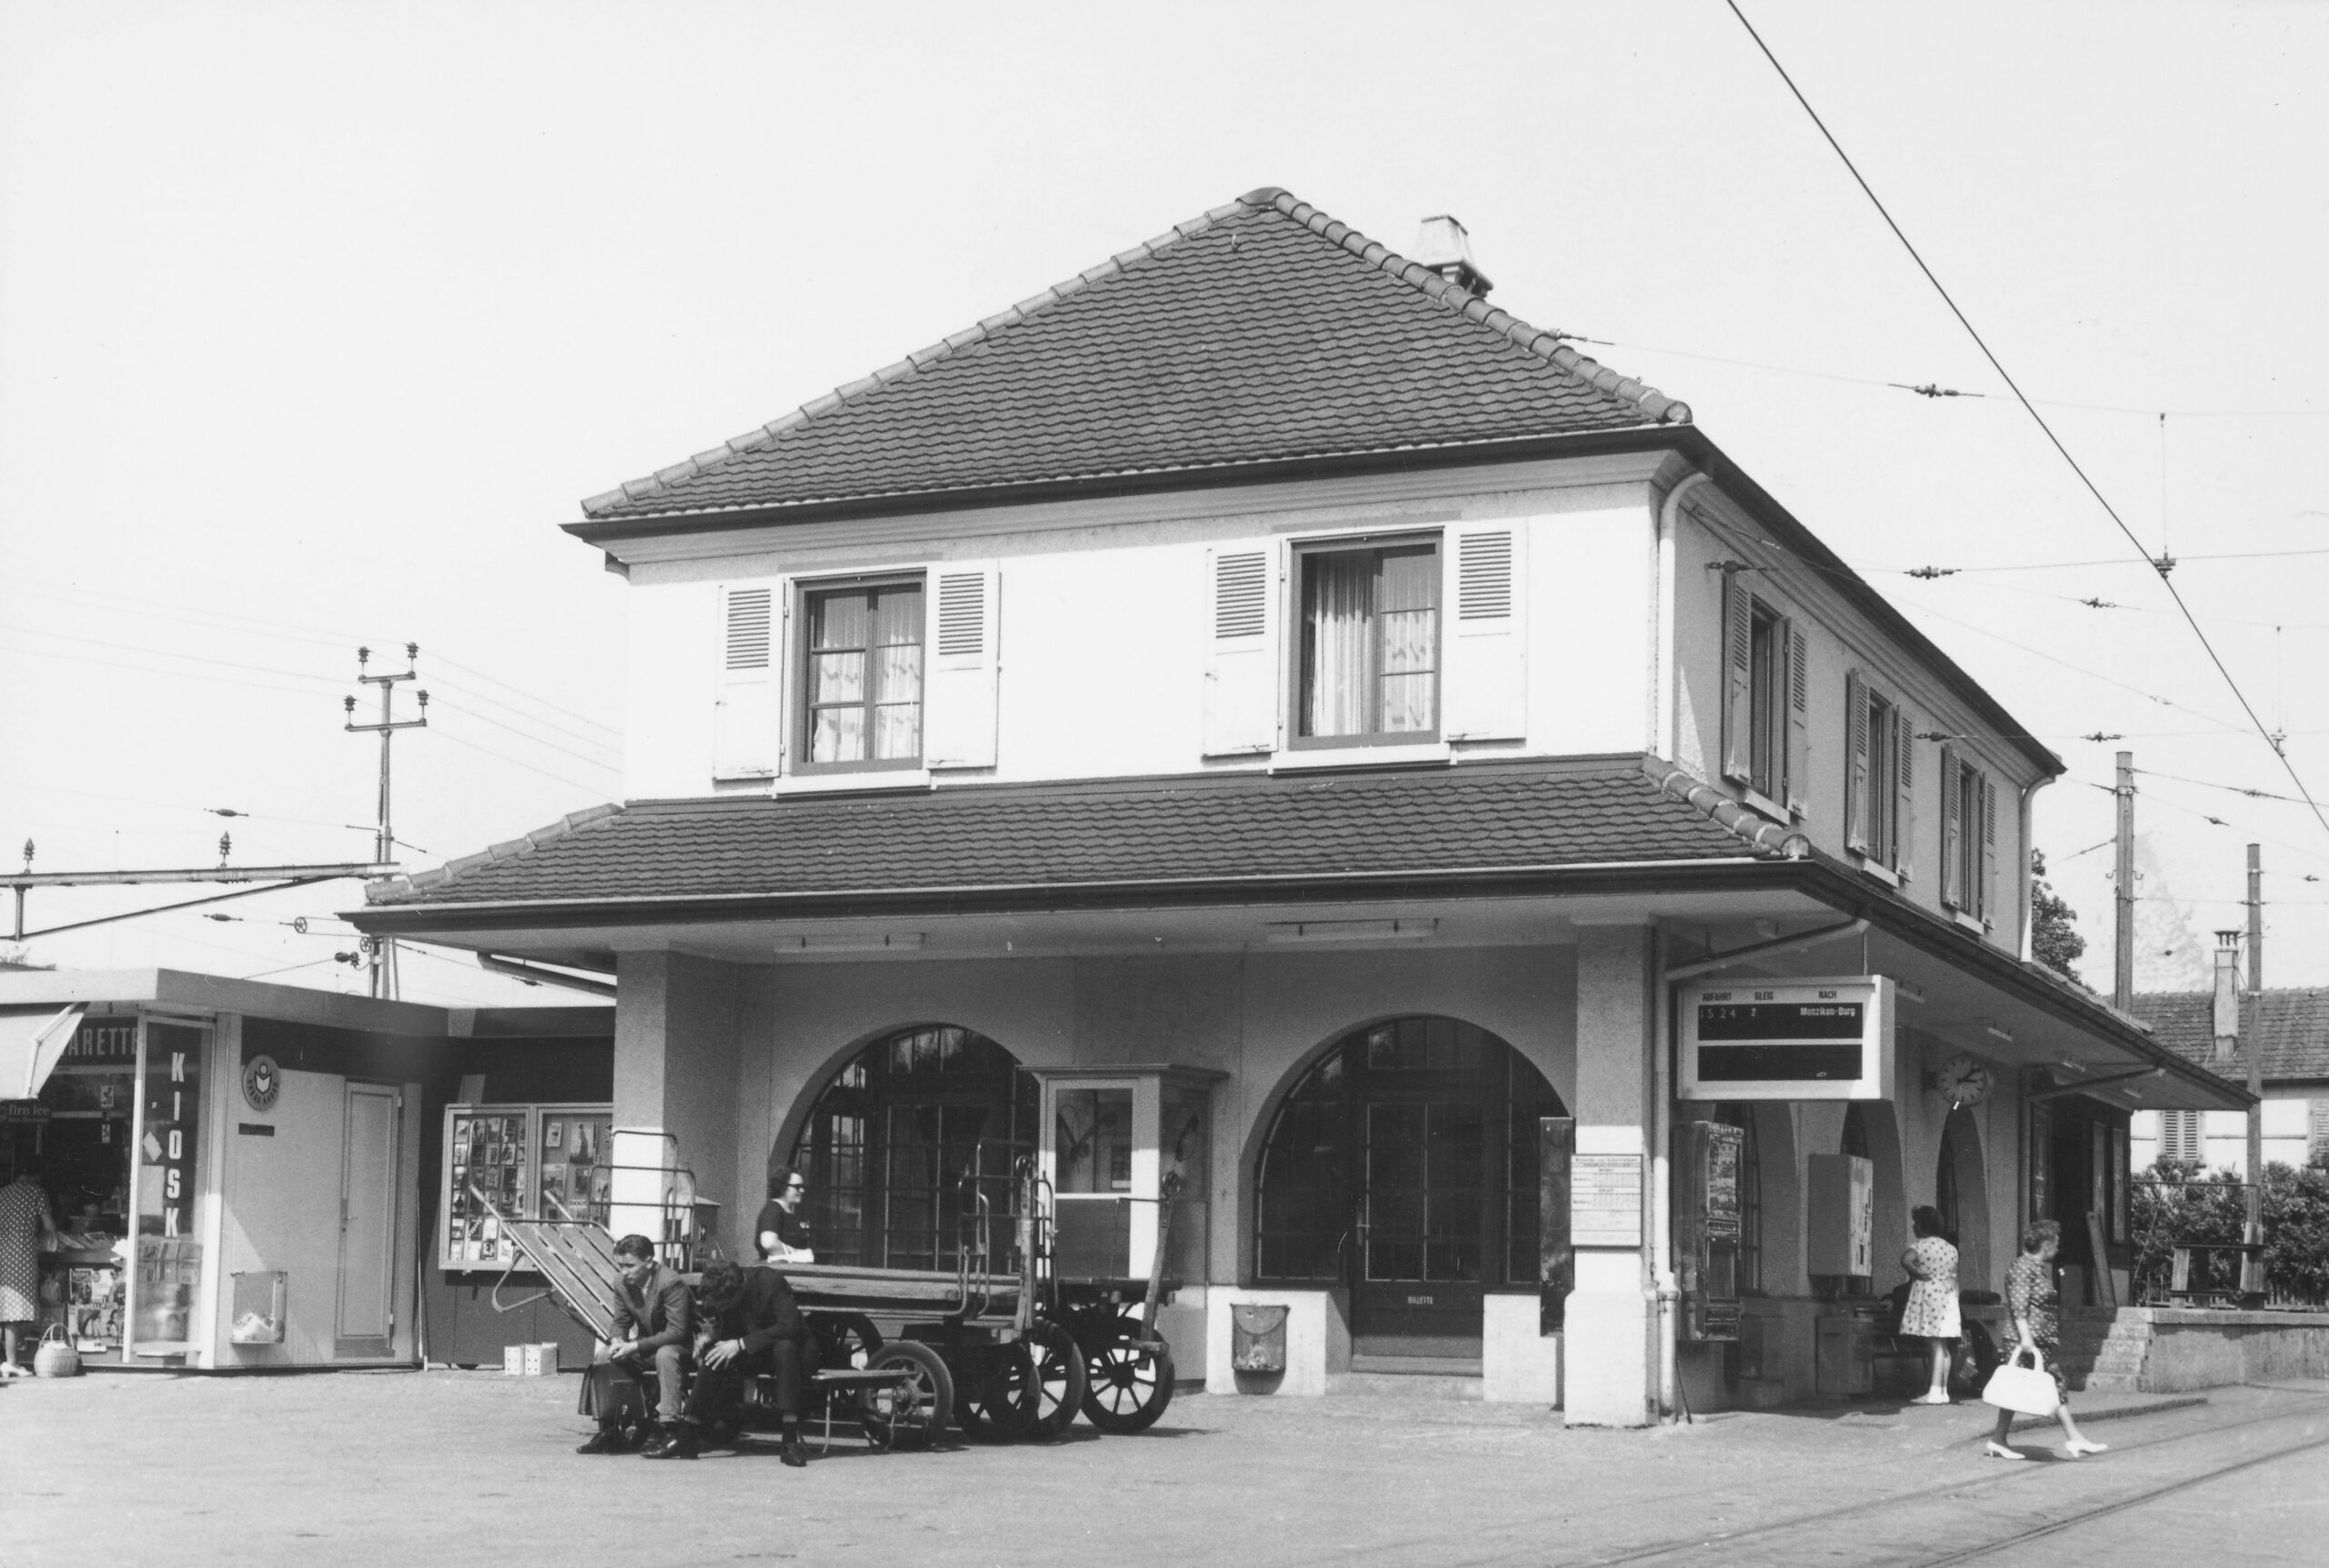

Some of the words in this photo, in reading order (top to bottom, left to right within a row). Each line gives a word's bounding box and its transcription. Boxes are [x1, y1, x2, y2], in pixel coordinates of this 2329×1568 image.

[1702, 992, 1732, 1001] ABFAHRT
[1754, 991, 1774, 1000] GLEIS
[1819, 990, 1837, 1000] NACH
[1750, 1008, 1757, 1017] 2
[165, 1051, 186, 1238] KIOSK
[1407, 1296, 1434, 1304] BILLETTE
